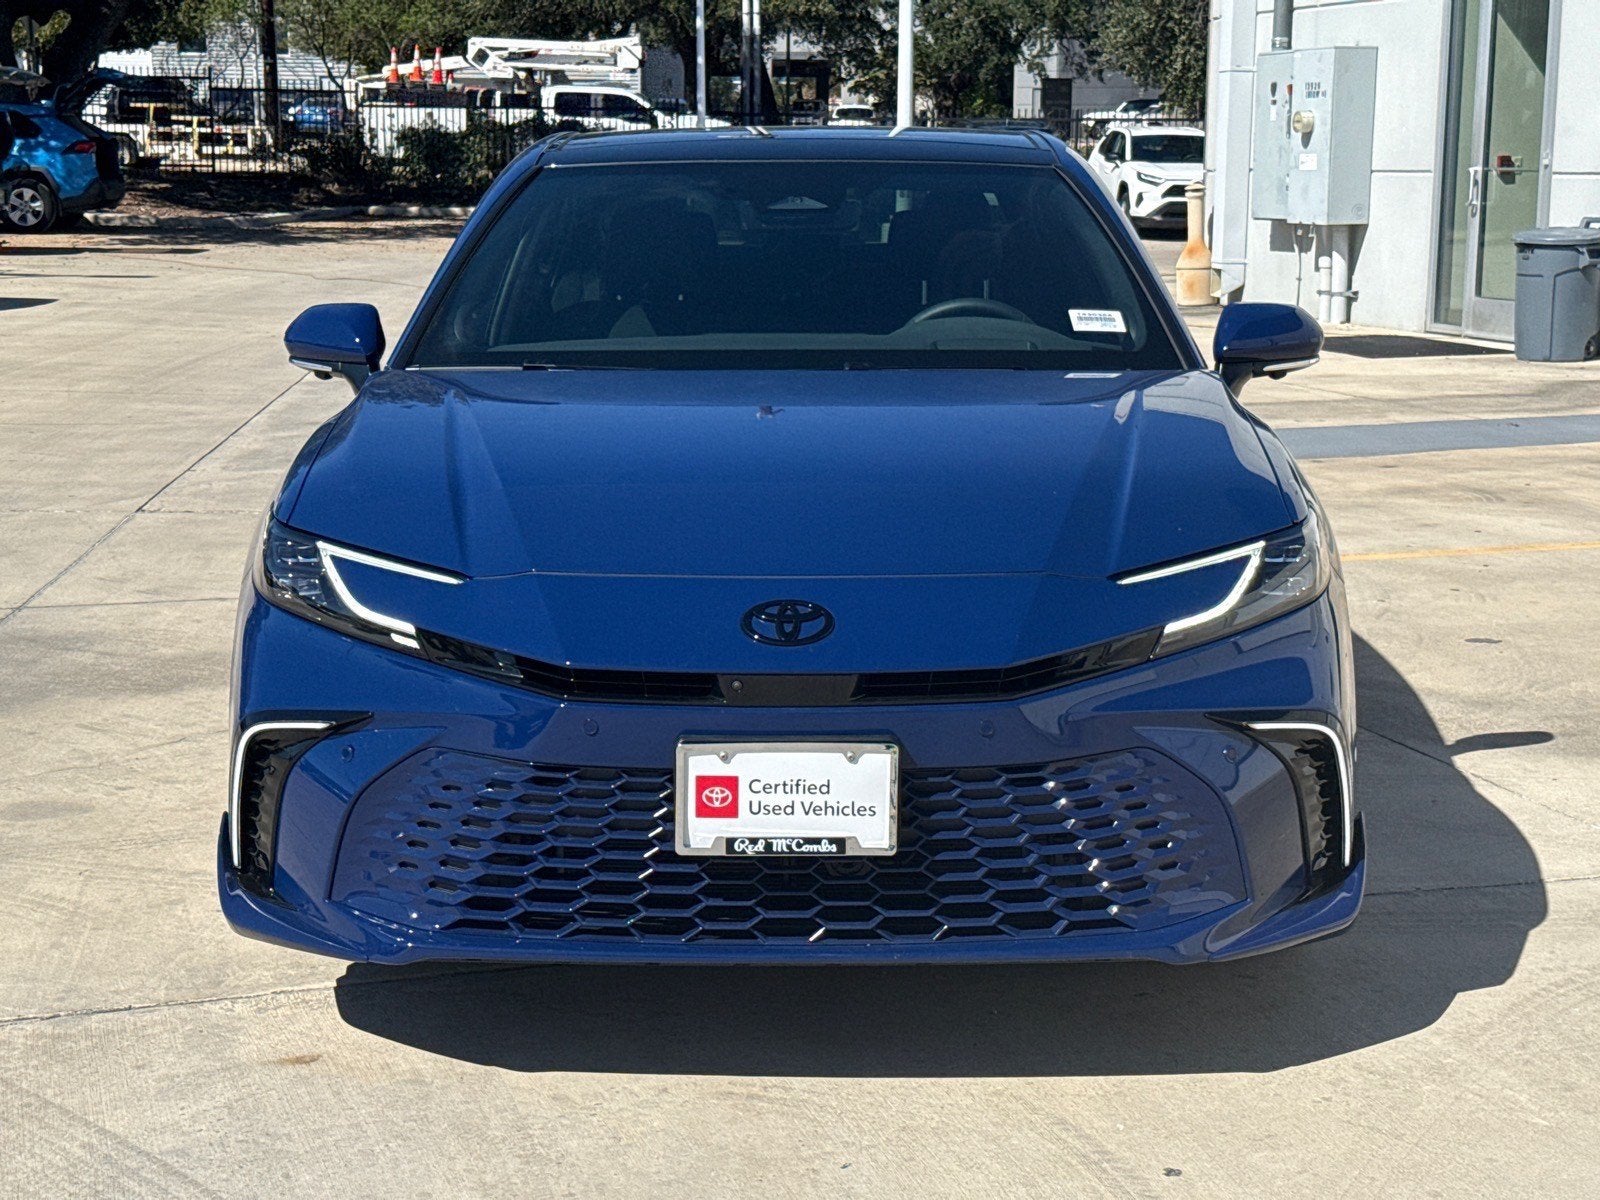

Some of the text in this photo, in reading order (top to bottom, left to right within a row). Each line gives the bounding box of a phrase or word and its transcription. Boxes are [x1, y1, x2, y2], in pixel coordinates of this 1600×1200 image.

[748, 778, 831, 795] Certified
[748, 800, 877, 817] Used Vehicles
[733, 837, 837, 854] Red McCombs
